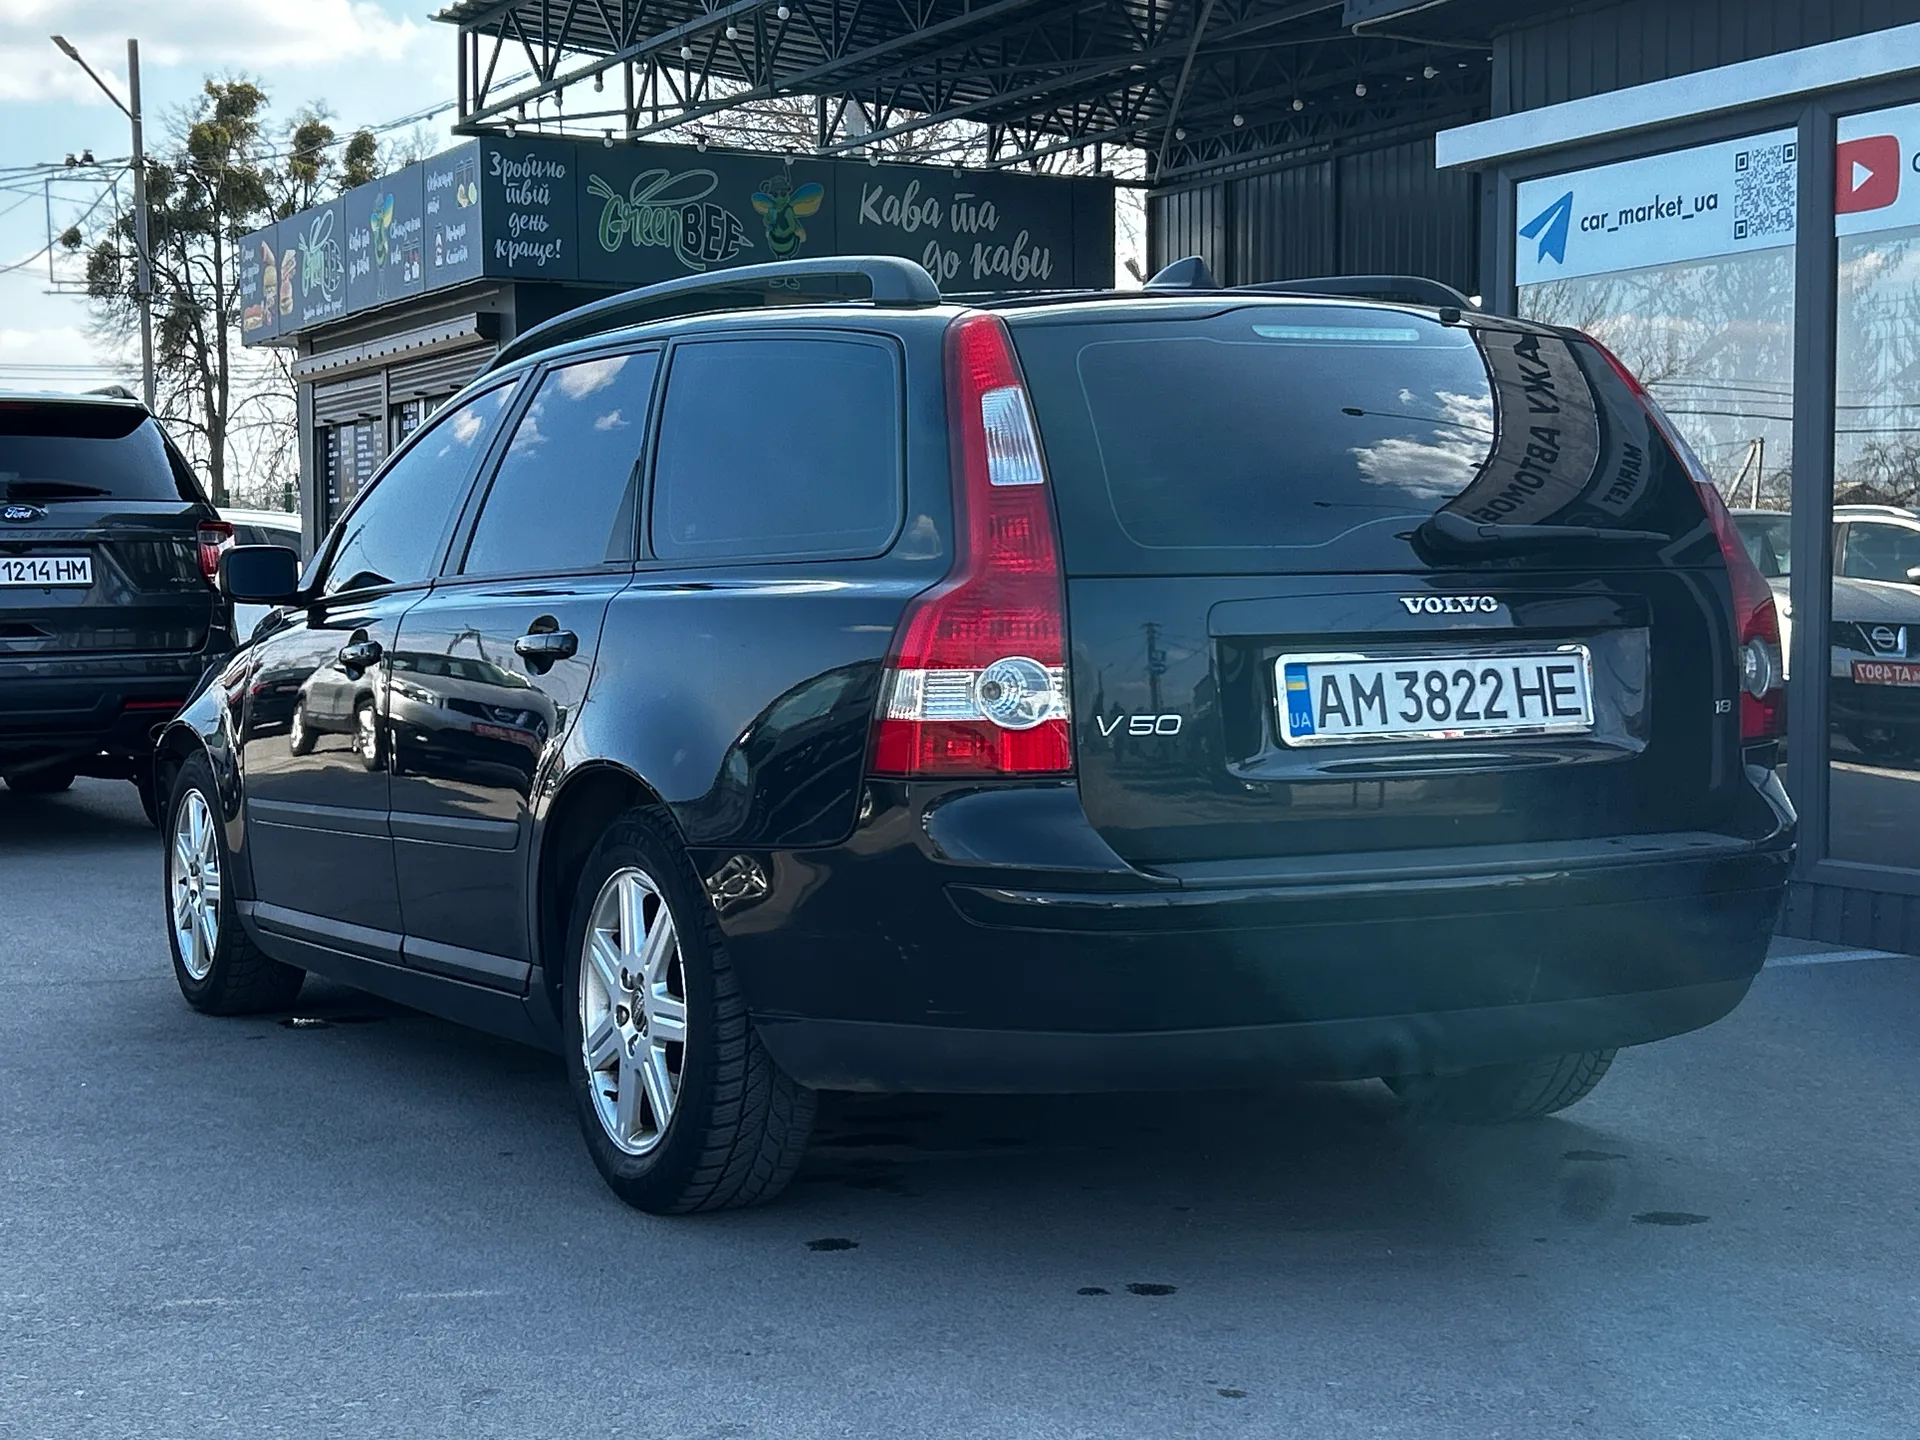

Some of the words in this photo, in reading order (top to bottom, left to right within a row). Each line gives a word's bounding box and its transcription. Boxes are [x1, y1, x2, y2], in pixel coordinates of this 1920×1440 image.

[489, 151, 566, 187] Зробимо
[505, 180, 551, 206] твій
[859, 179, 943, 233] Кава
[952, 192, 1000, 234] та
[508, 211, 550, 238] день
[1580, 191, 1718, 233] car_market_ua
[494, 239, 561, 267] краще!
[922, 239, 962, 285] до
[970, 229, 1053, 282] кави
[5, 507, 32, 519] Ford
[2, 560, 50, 581] 1214
[56, 560, 87, 580] HM
[1400, 596, 1498, 614] VOLVO
[1290, 712, 1312, 729] UA
